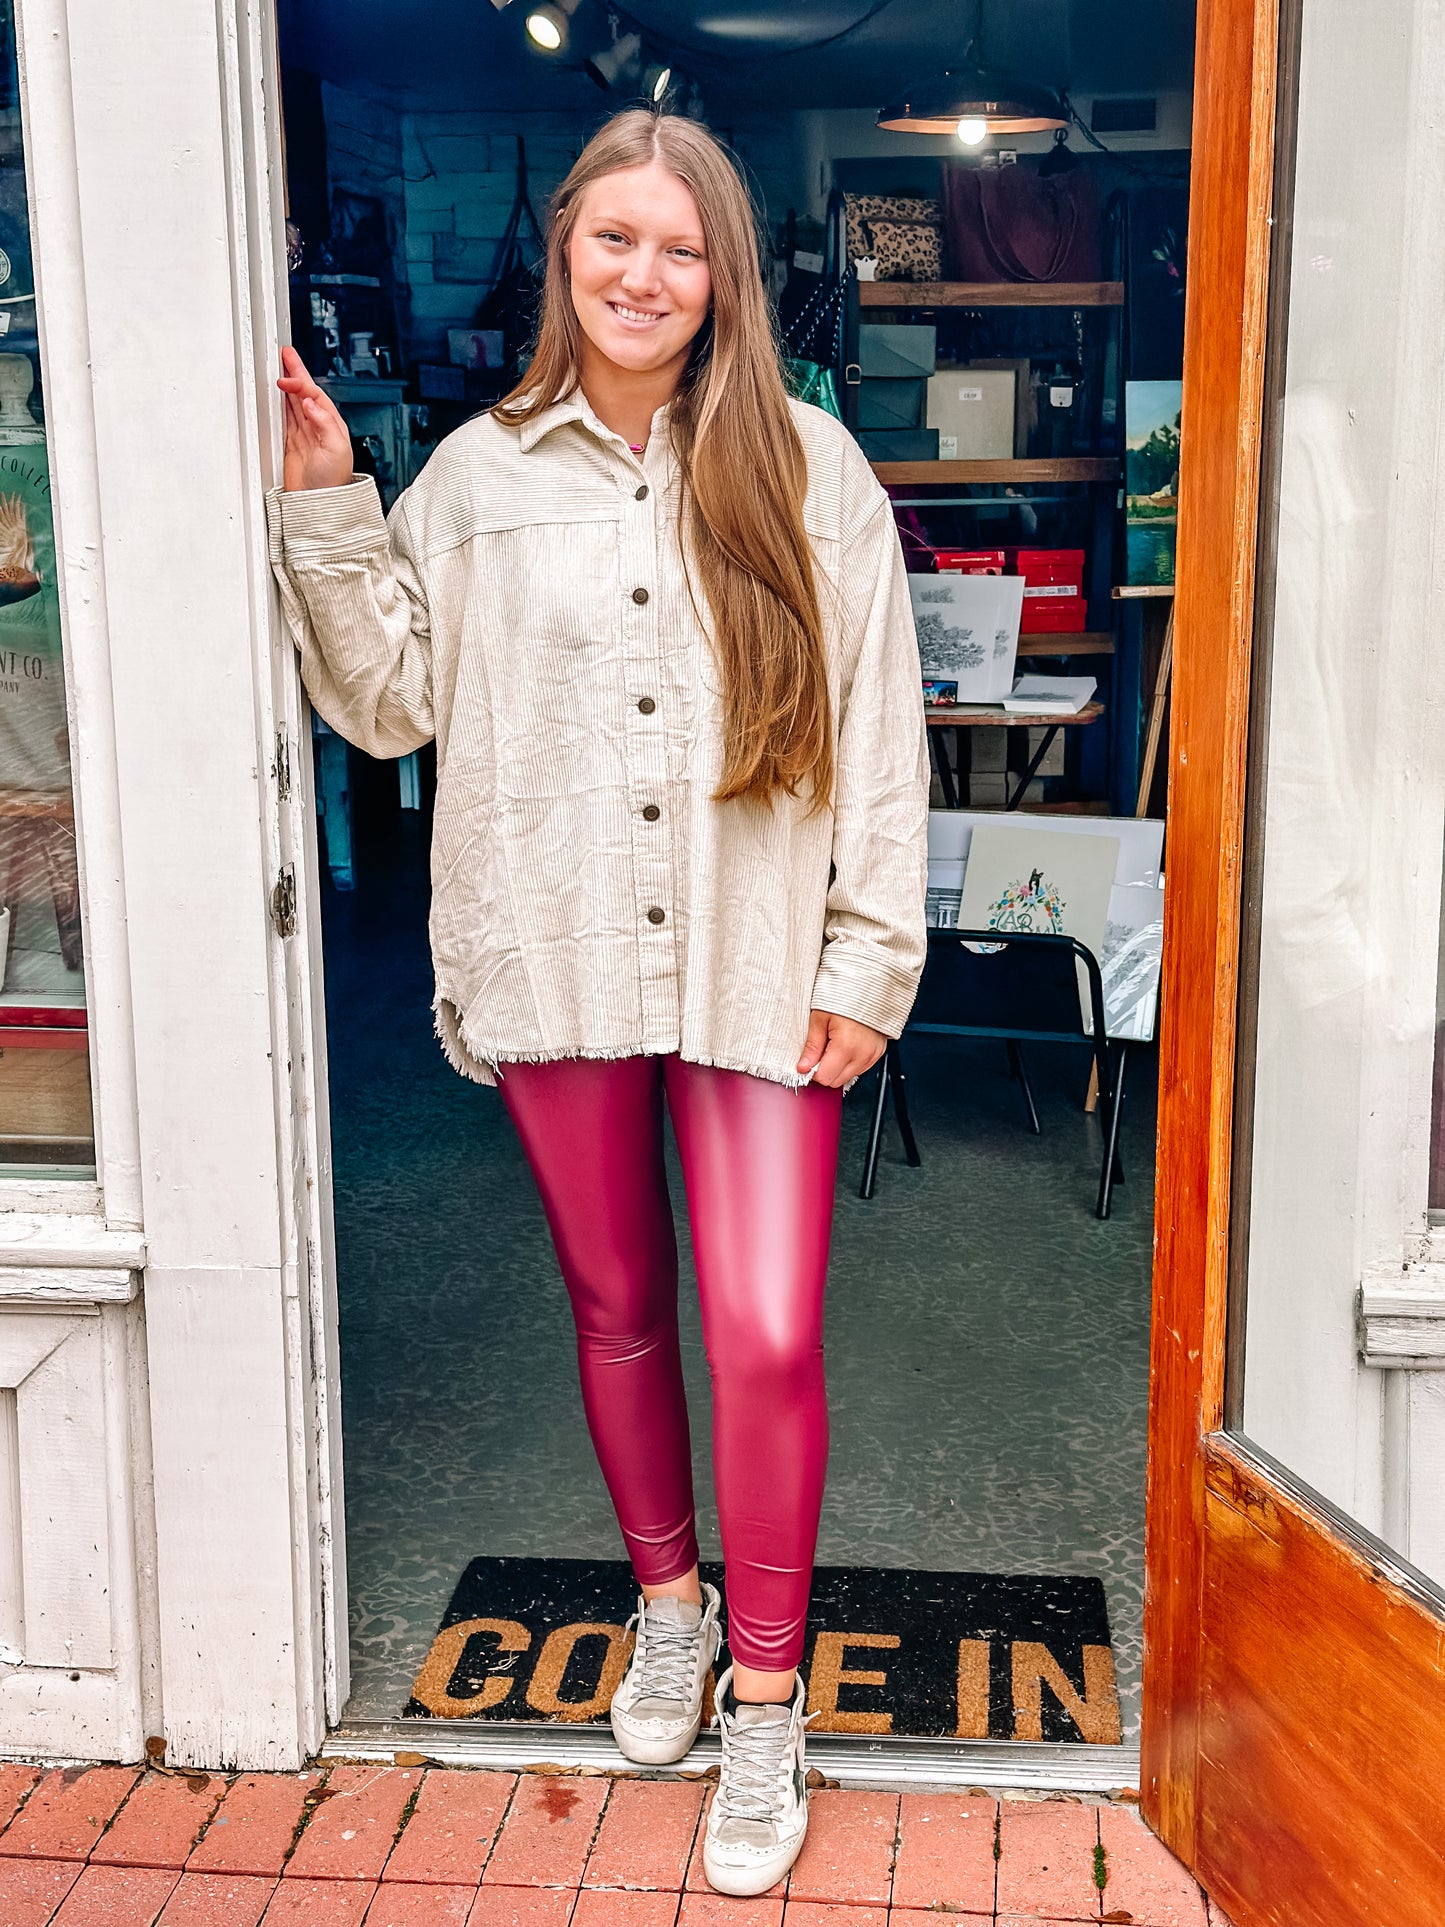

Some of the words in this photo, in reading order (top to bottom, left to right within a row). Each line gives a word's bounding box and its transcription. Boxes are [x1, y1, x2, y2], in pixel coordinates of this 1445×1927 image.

[24, 655, 48, 680] CO.
[410, 1617, 901, 1735] COE
[956, 1638, 1122, 1745] IN
